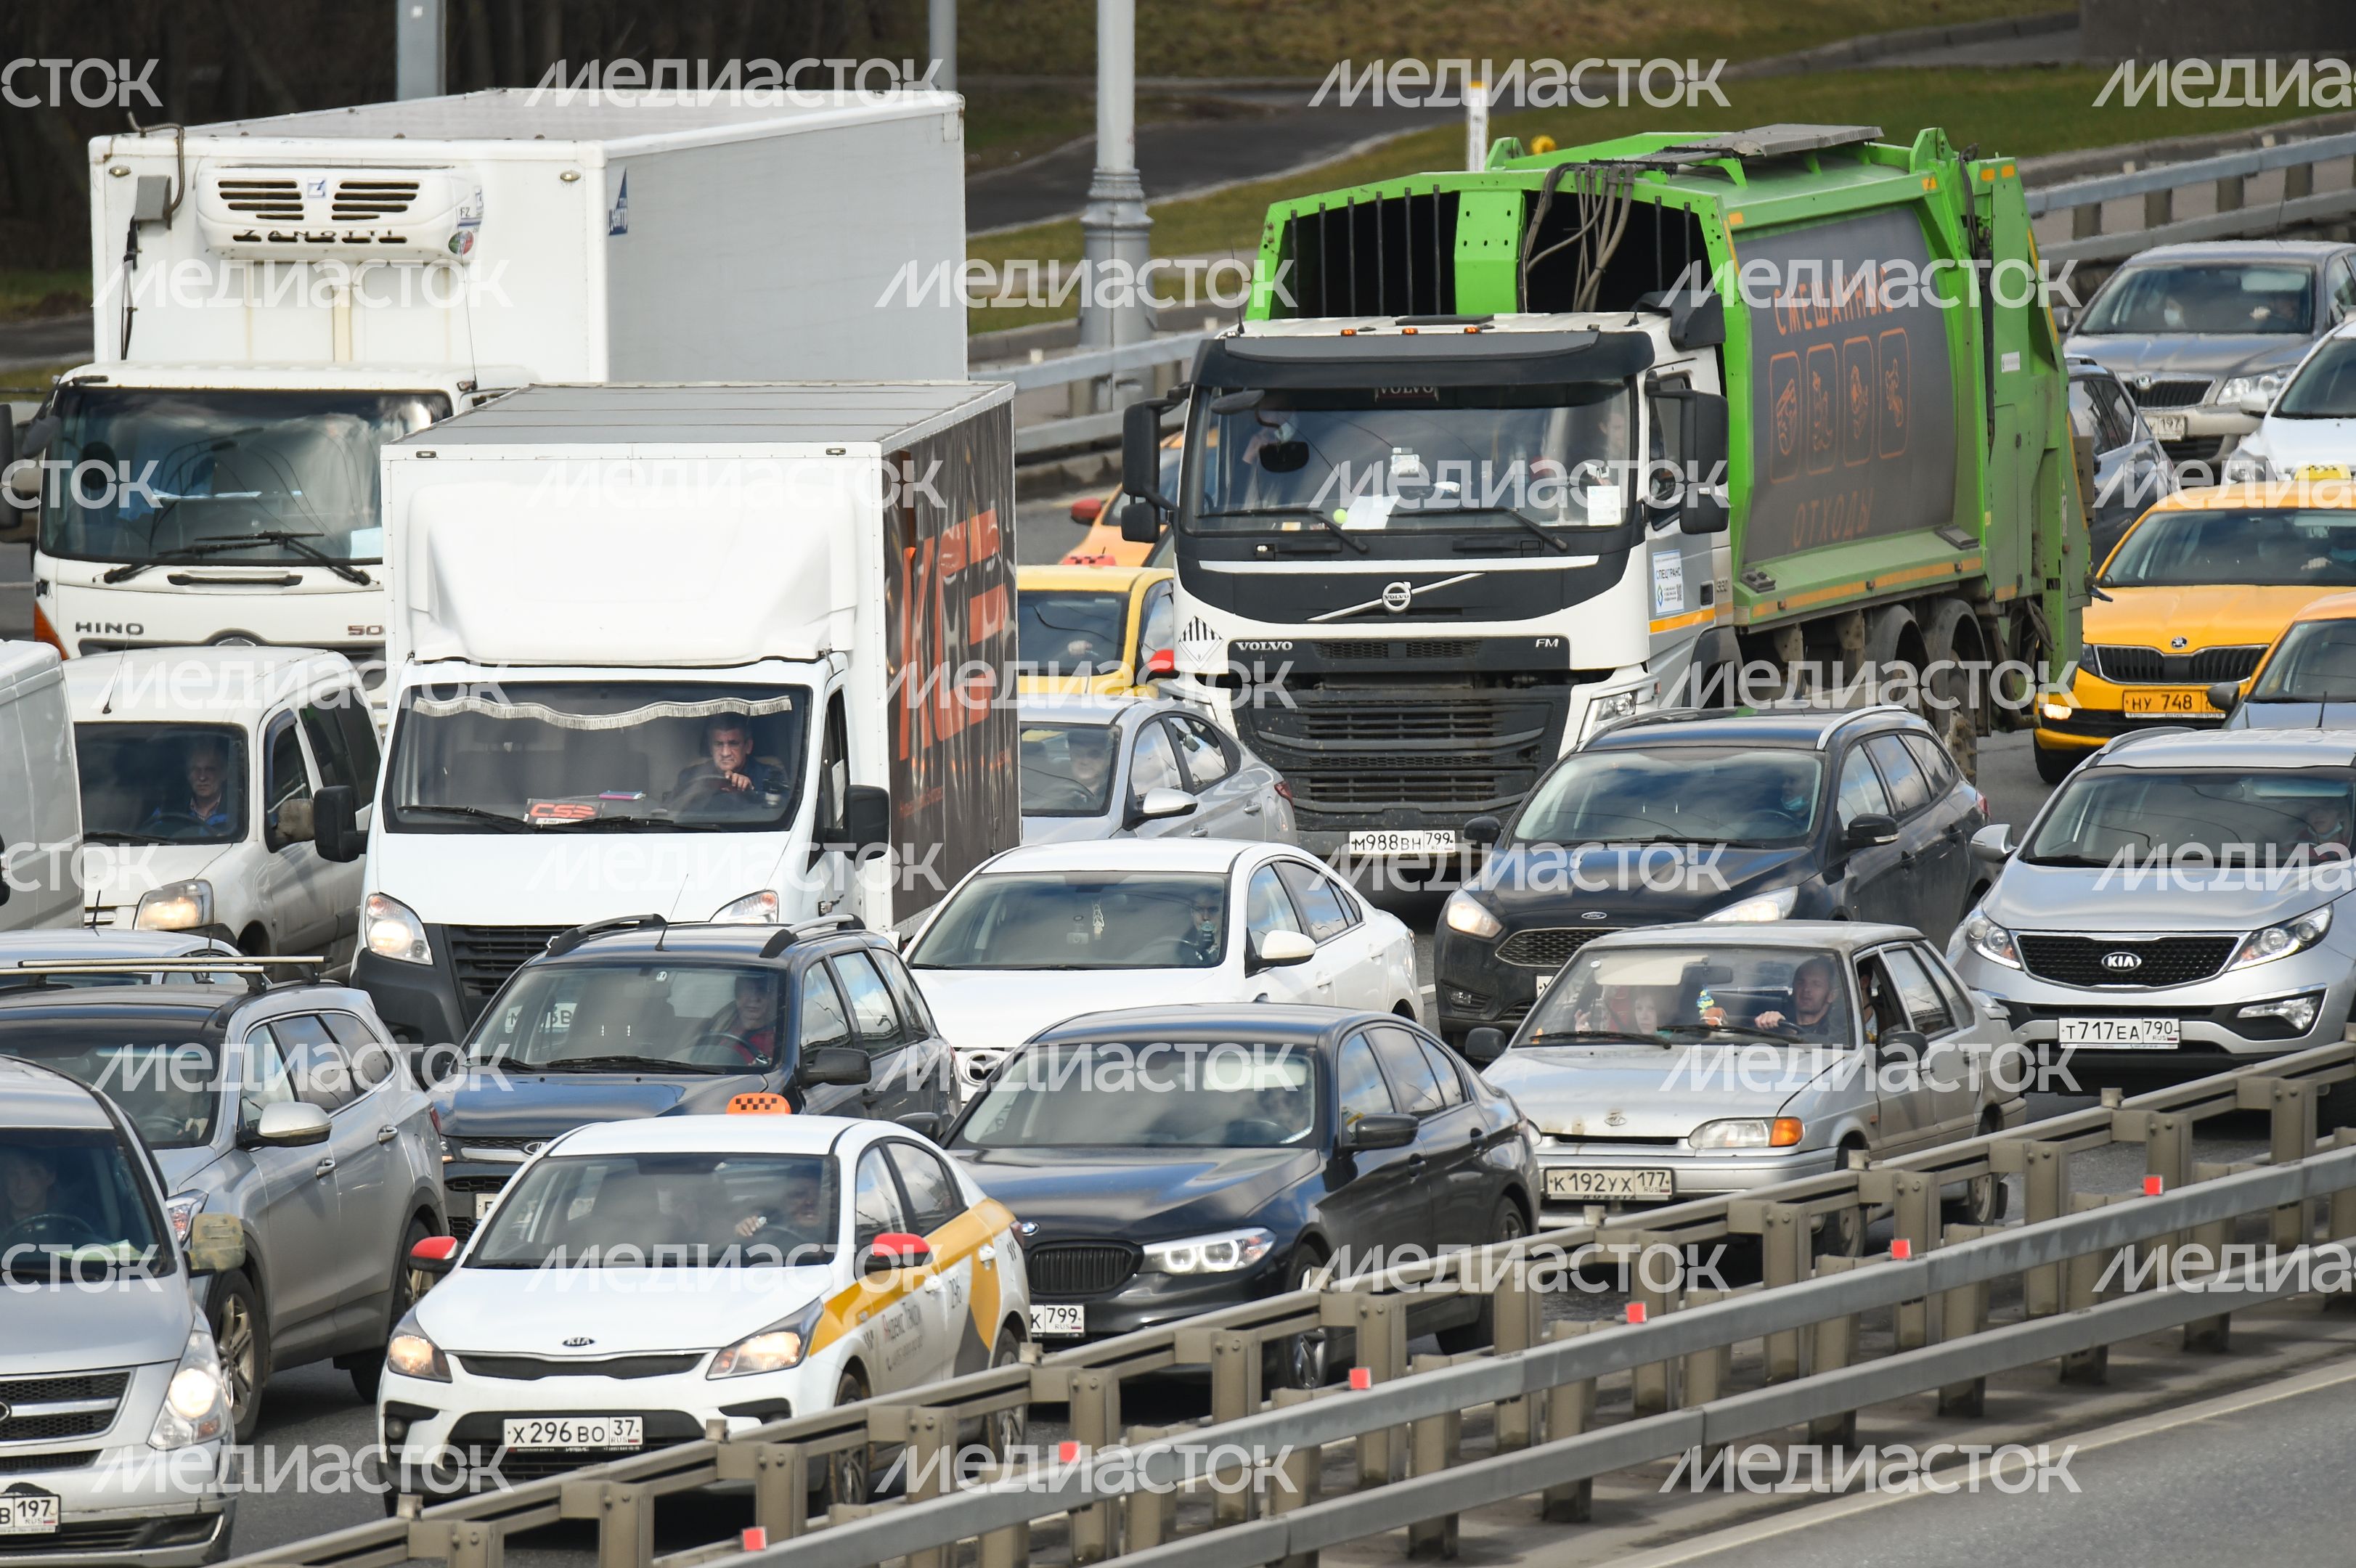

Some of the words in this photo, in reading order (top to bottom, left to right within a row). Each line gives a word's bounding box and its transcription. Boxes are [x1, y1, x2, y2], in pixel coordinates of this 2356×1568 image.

[1793, 488, 1873, 550] ОТХОДЫ
[76, 621, 144, 635] HINO
[1236, 641, 1293, 651] VOLVO
[1536, 638, 1559, 648] FM
[2161, 694, 2193, 710] 748
[1425, 833, 1451, 845] 799
[2107, 955, 2135, 967] KIA
[2144, 1021, 2173, 1035] 790
[1637, 1172, 1666, 1186] 177
[1047, 1307, 1077, 1323] 799
[614, 1419, 635, 1436] 37
[17, 1499, 52, 1517] 197
